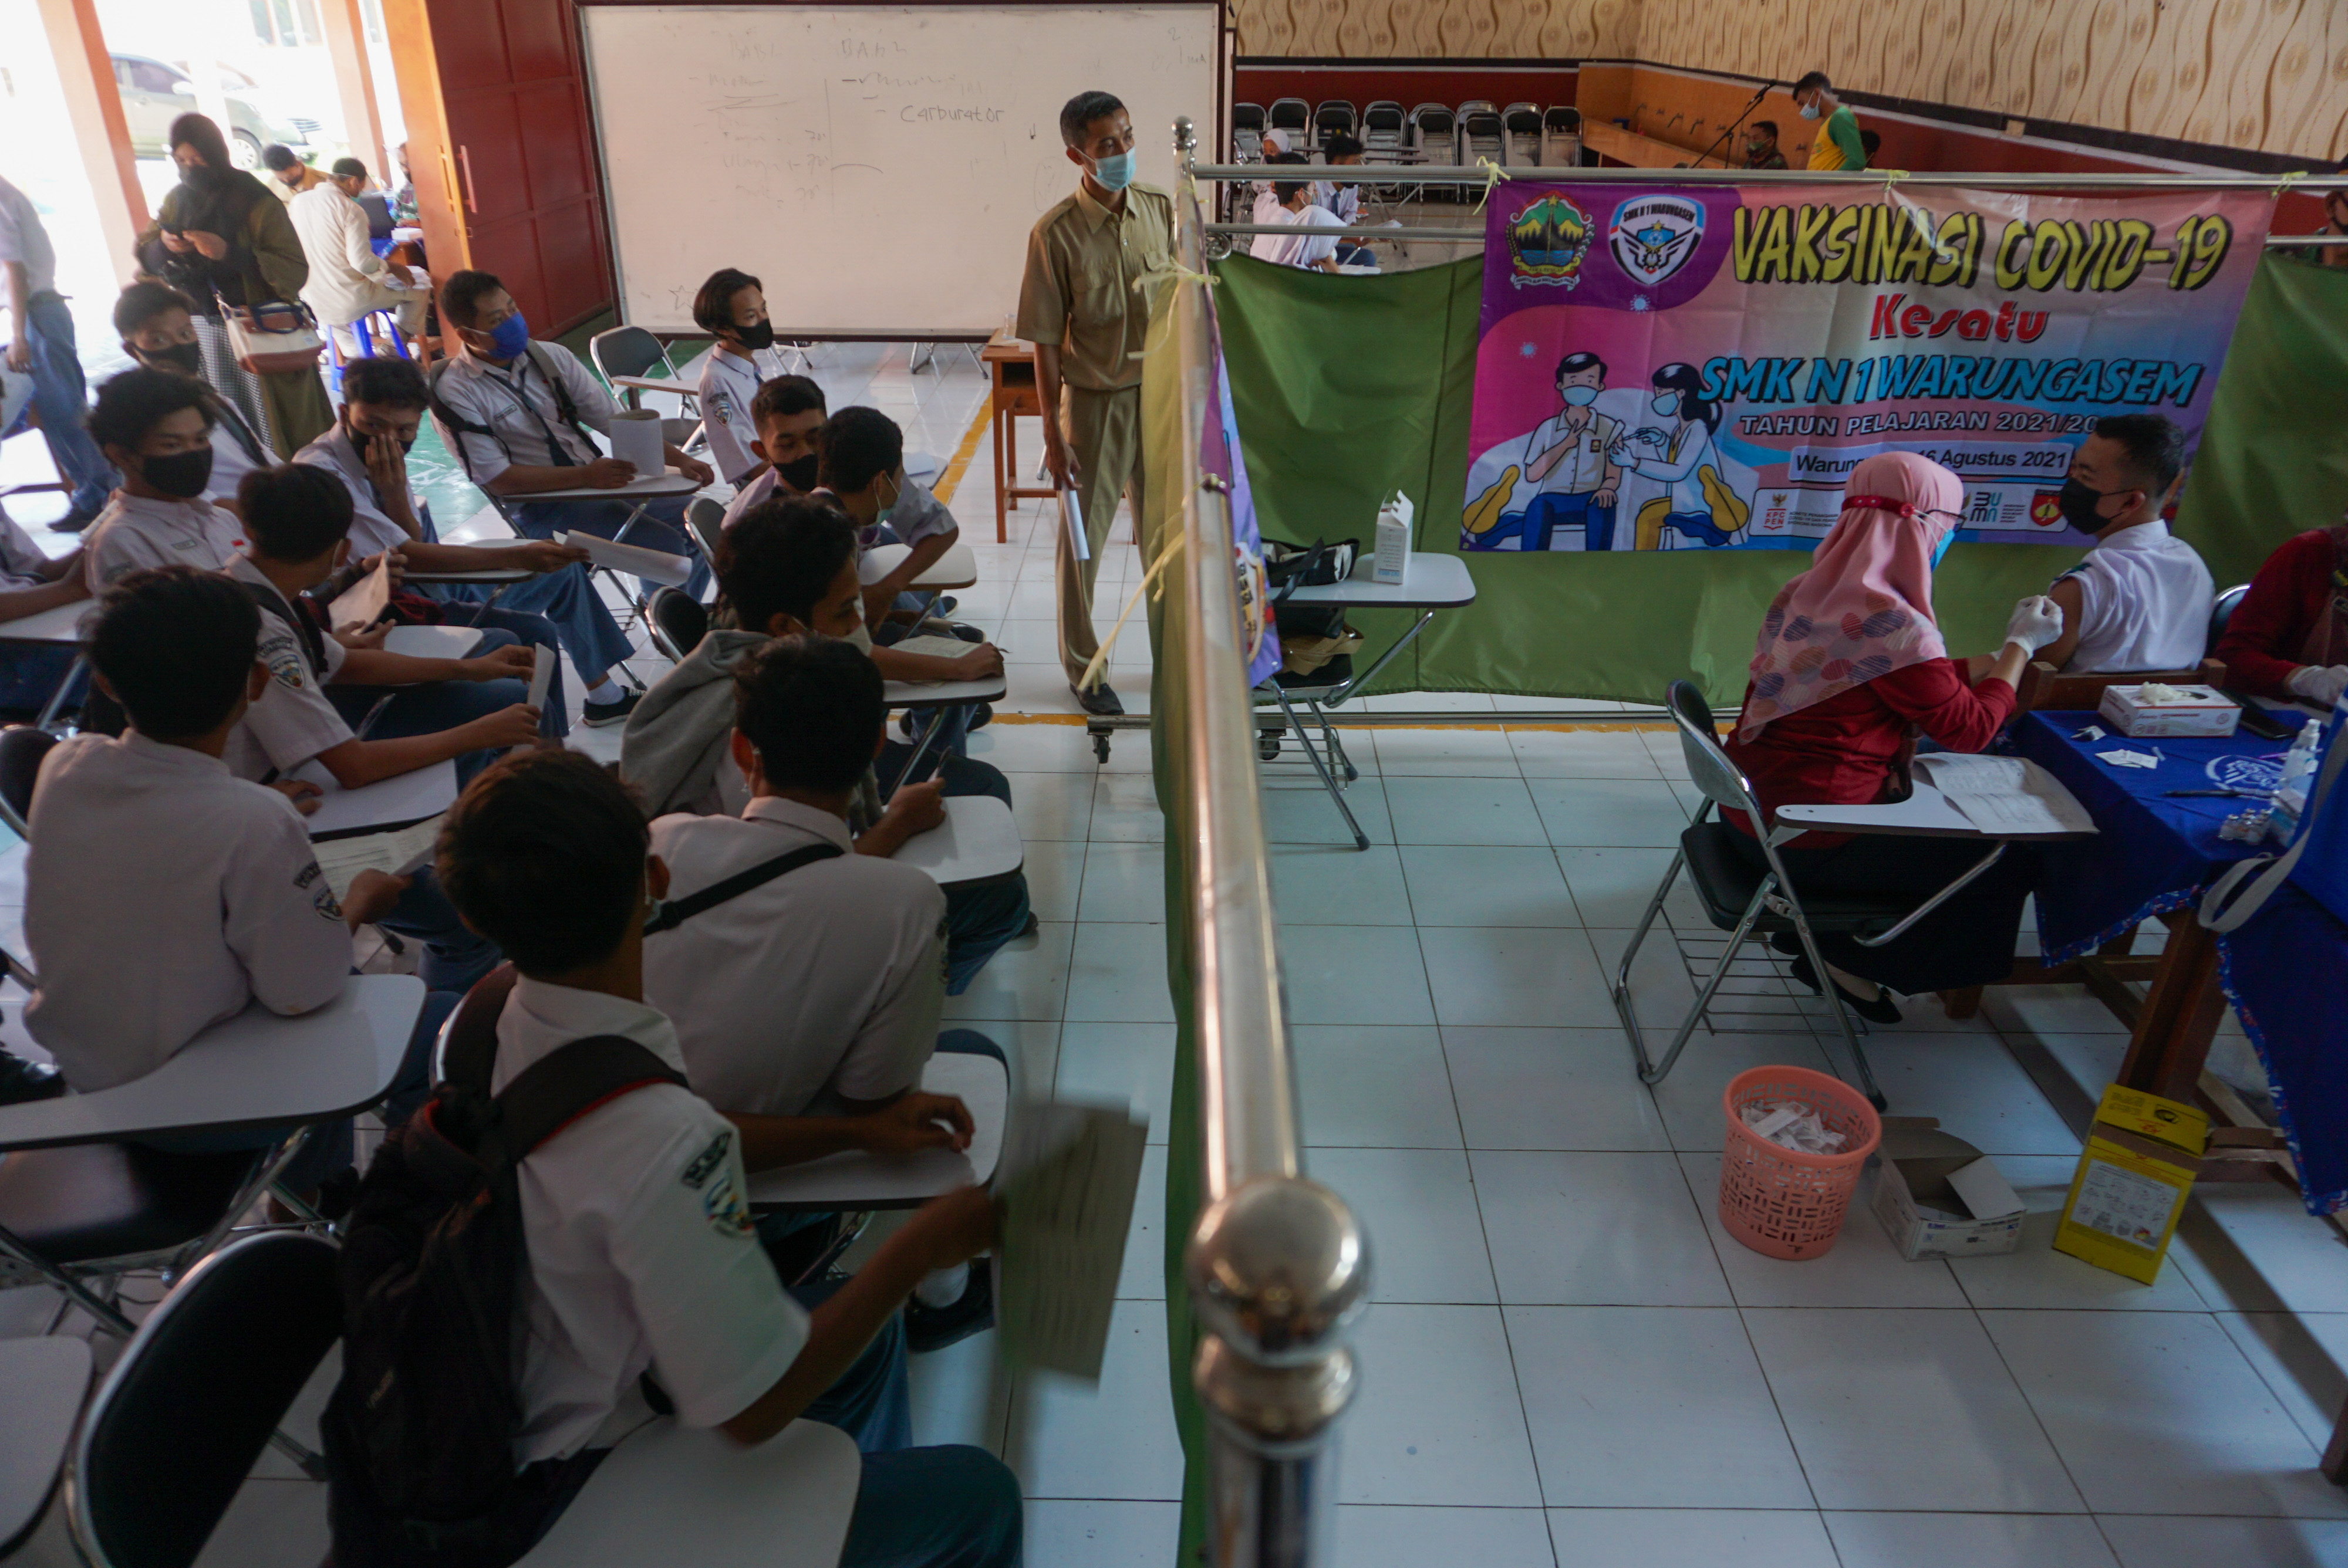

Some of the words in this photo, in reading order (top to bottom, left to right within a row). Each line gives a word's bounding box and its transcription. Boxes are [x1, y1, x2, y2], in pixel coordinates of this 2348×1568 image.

[900, 104, 1006, 123] Carburator
[1624, 207, 1639, 222] SMK
[1650, 203, 1695, 223] WARUNGASEM
[1733, 203, 1985, 288] VAKSINASI
[1996, 213, 2233, 292] COVID-19
[1869, 293, 2050, 343] Kesatu
[1698, 356, 1807, 403] SMK
[1804, 357, 1853, 404] N
[1854, 357, 1875, 403] 1
[1878, 354, 2206, 407] WARUNGASEM
[1740, 415, 1839, 436] TAHUN
[1845, 410, 1990, 436] PELAJARAN
[1996, 411, 2098, 434] 2021/20
[1797, 454, 1864, 474] Warun
[1939, 448, 2018, 468] Agustus
[2022, 451, 2067, 469] 2021
